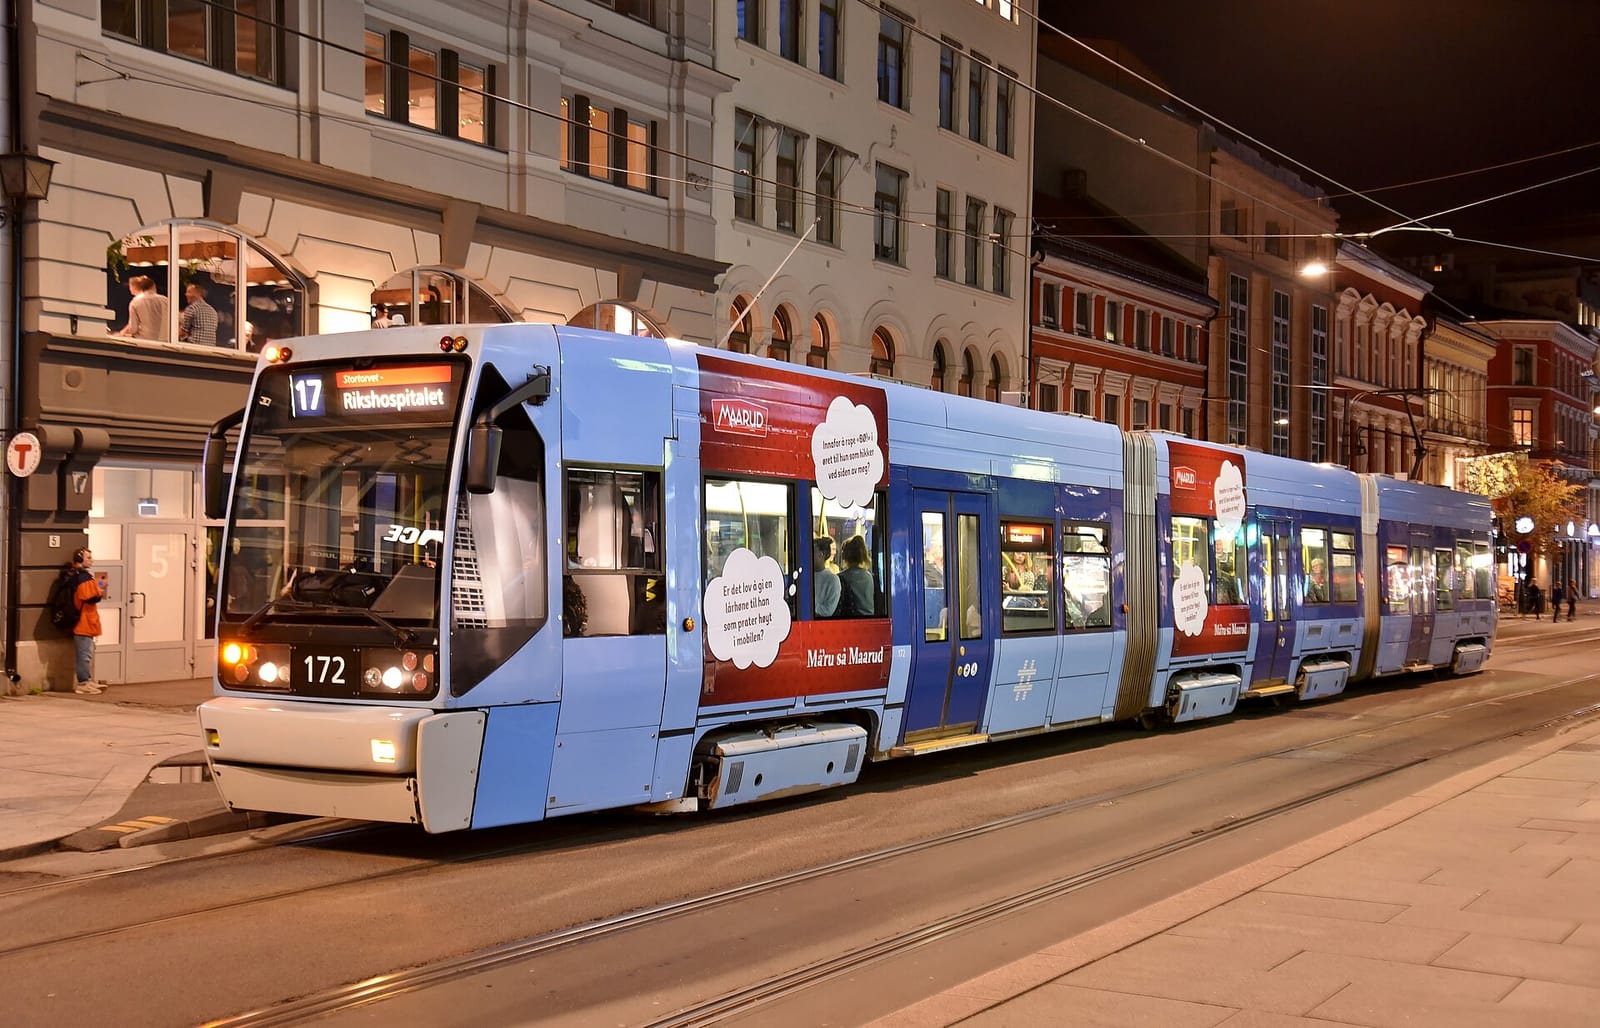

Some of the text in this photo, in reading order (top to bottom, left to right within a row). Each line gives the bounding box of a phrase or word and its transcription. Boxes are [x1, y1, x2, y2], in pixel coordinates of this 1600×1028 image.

[343, 373, 379, 384] Stortorvet
[295, 379, 322, 411] 17
[343, 387, 444, 412] Rikshospitalet
[718, 404, 764, 428] MAARUD
[822, 438, 841, 449] Innafor
[841, 436, 845, 446] å
[846, 437, 856, 447] rope
[15, 444, 32, 470] T
[822, 455, 833, 466] øret
[840, 452, 849, 462] hun
[850, 452, 859, 461] som
[860, 447, 874, 458] hikker
[828, 461, 871, 479] ved siden av meg?
[151, 544, 169, 578] 5
[723, 579, 772, 597] Er det lov å gi en
[725, 601, 749, 614] lårhøne
[758, 596, 769, 607] han
[723, 612, 772, 632] som prater høyt
[737, 629, 764, 646] mobilen?
[837, 647, 847, 666] så
[848, 645, 884, 665] Maarud
[304, 655, 346, 684] 172
